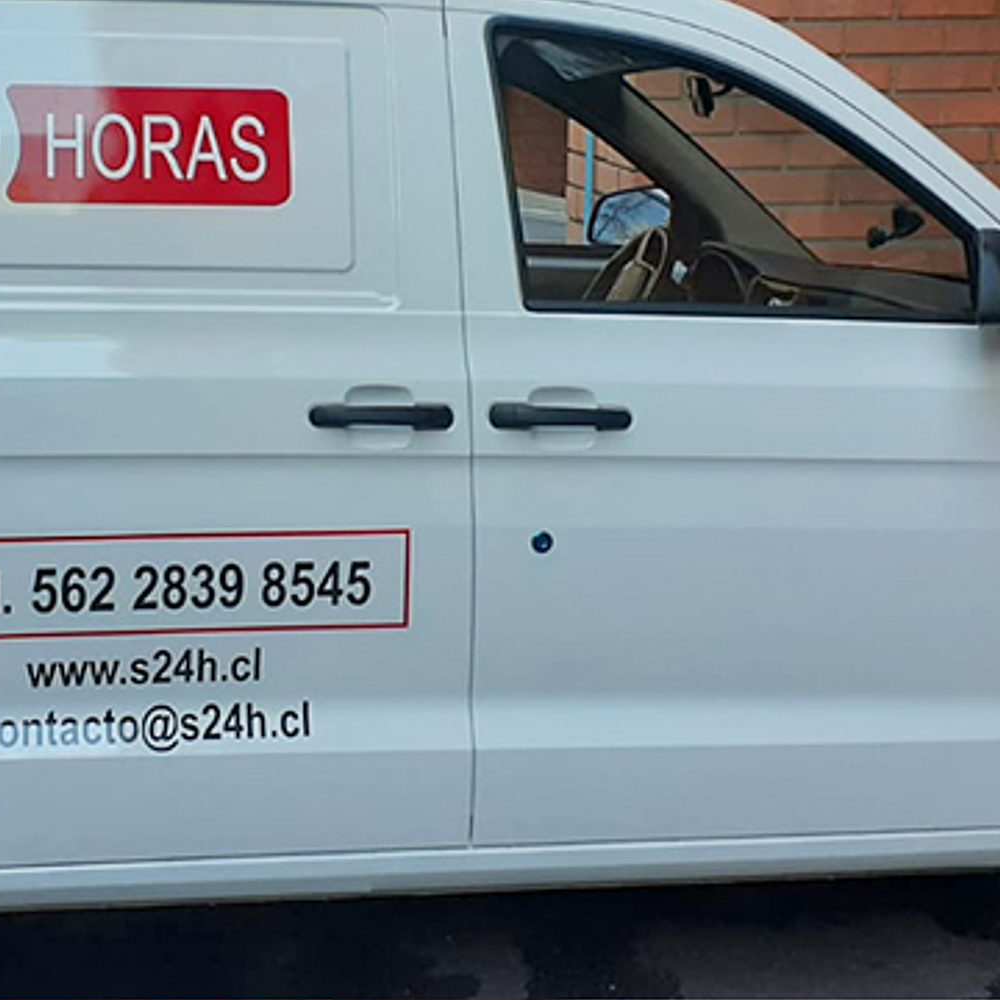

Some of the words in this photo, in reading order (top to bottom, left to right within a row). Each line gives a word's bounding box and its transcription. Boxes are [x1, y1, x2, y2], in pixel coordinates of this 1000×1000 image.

[43, 110, 270, 184] HORAS
[31, 566, 116, 613] 562
[132, 562, 244, 611] 2839
[261, 560, 372, 607] 8545
[27, 647, 262, 688] www.s24h.cl
